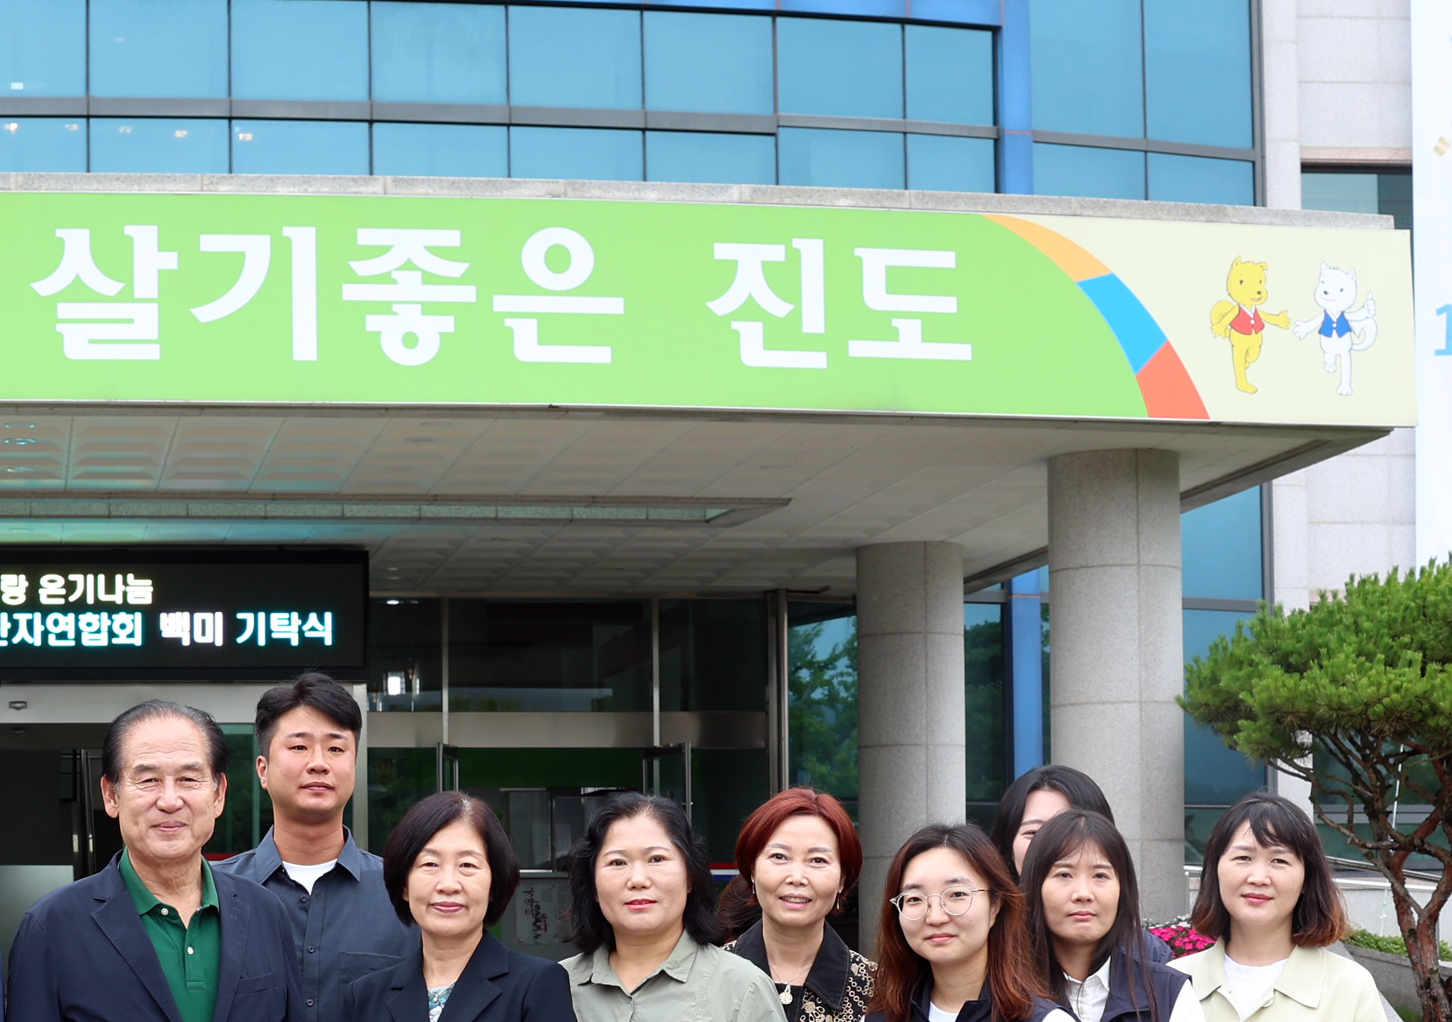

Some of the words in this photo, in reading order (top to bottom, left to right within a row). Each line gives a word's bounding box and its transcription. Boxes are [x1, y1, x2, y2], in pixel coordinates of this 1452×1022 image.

[29, 224, 625, 366] 살기좋은
[706, 238, 973, 369] 진도
[38, 573, 154, 606] 온기나눔
[158, 612, 224, 647] 백미
[236, 612, 333, 647] 기탁식
